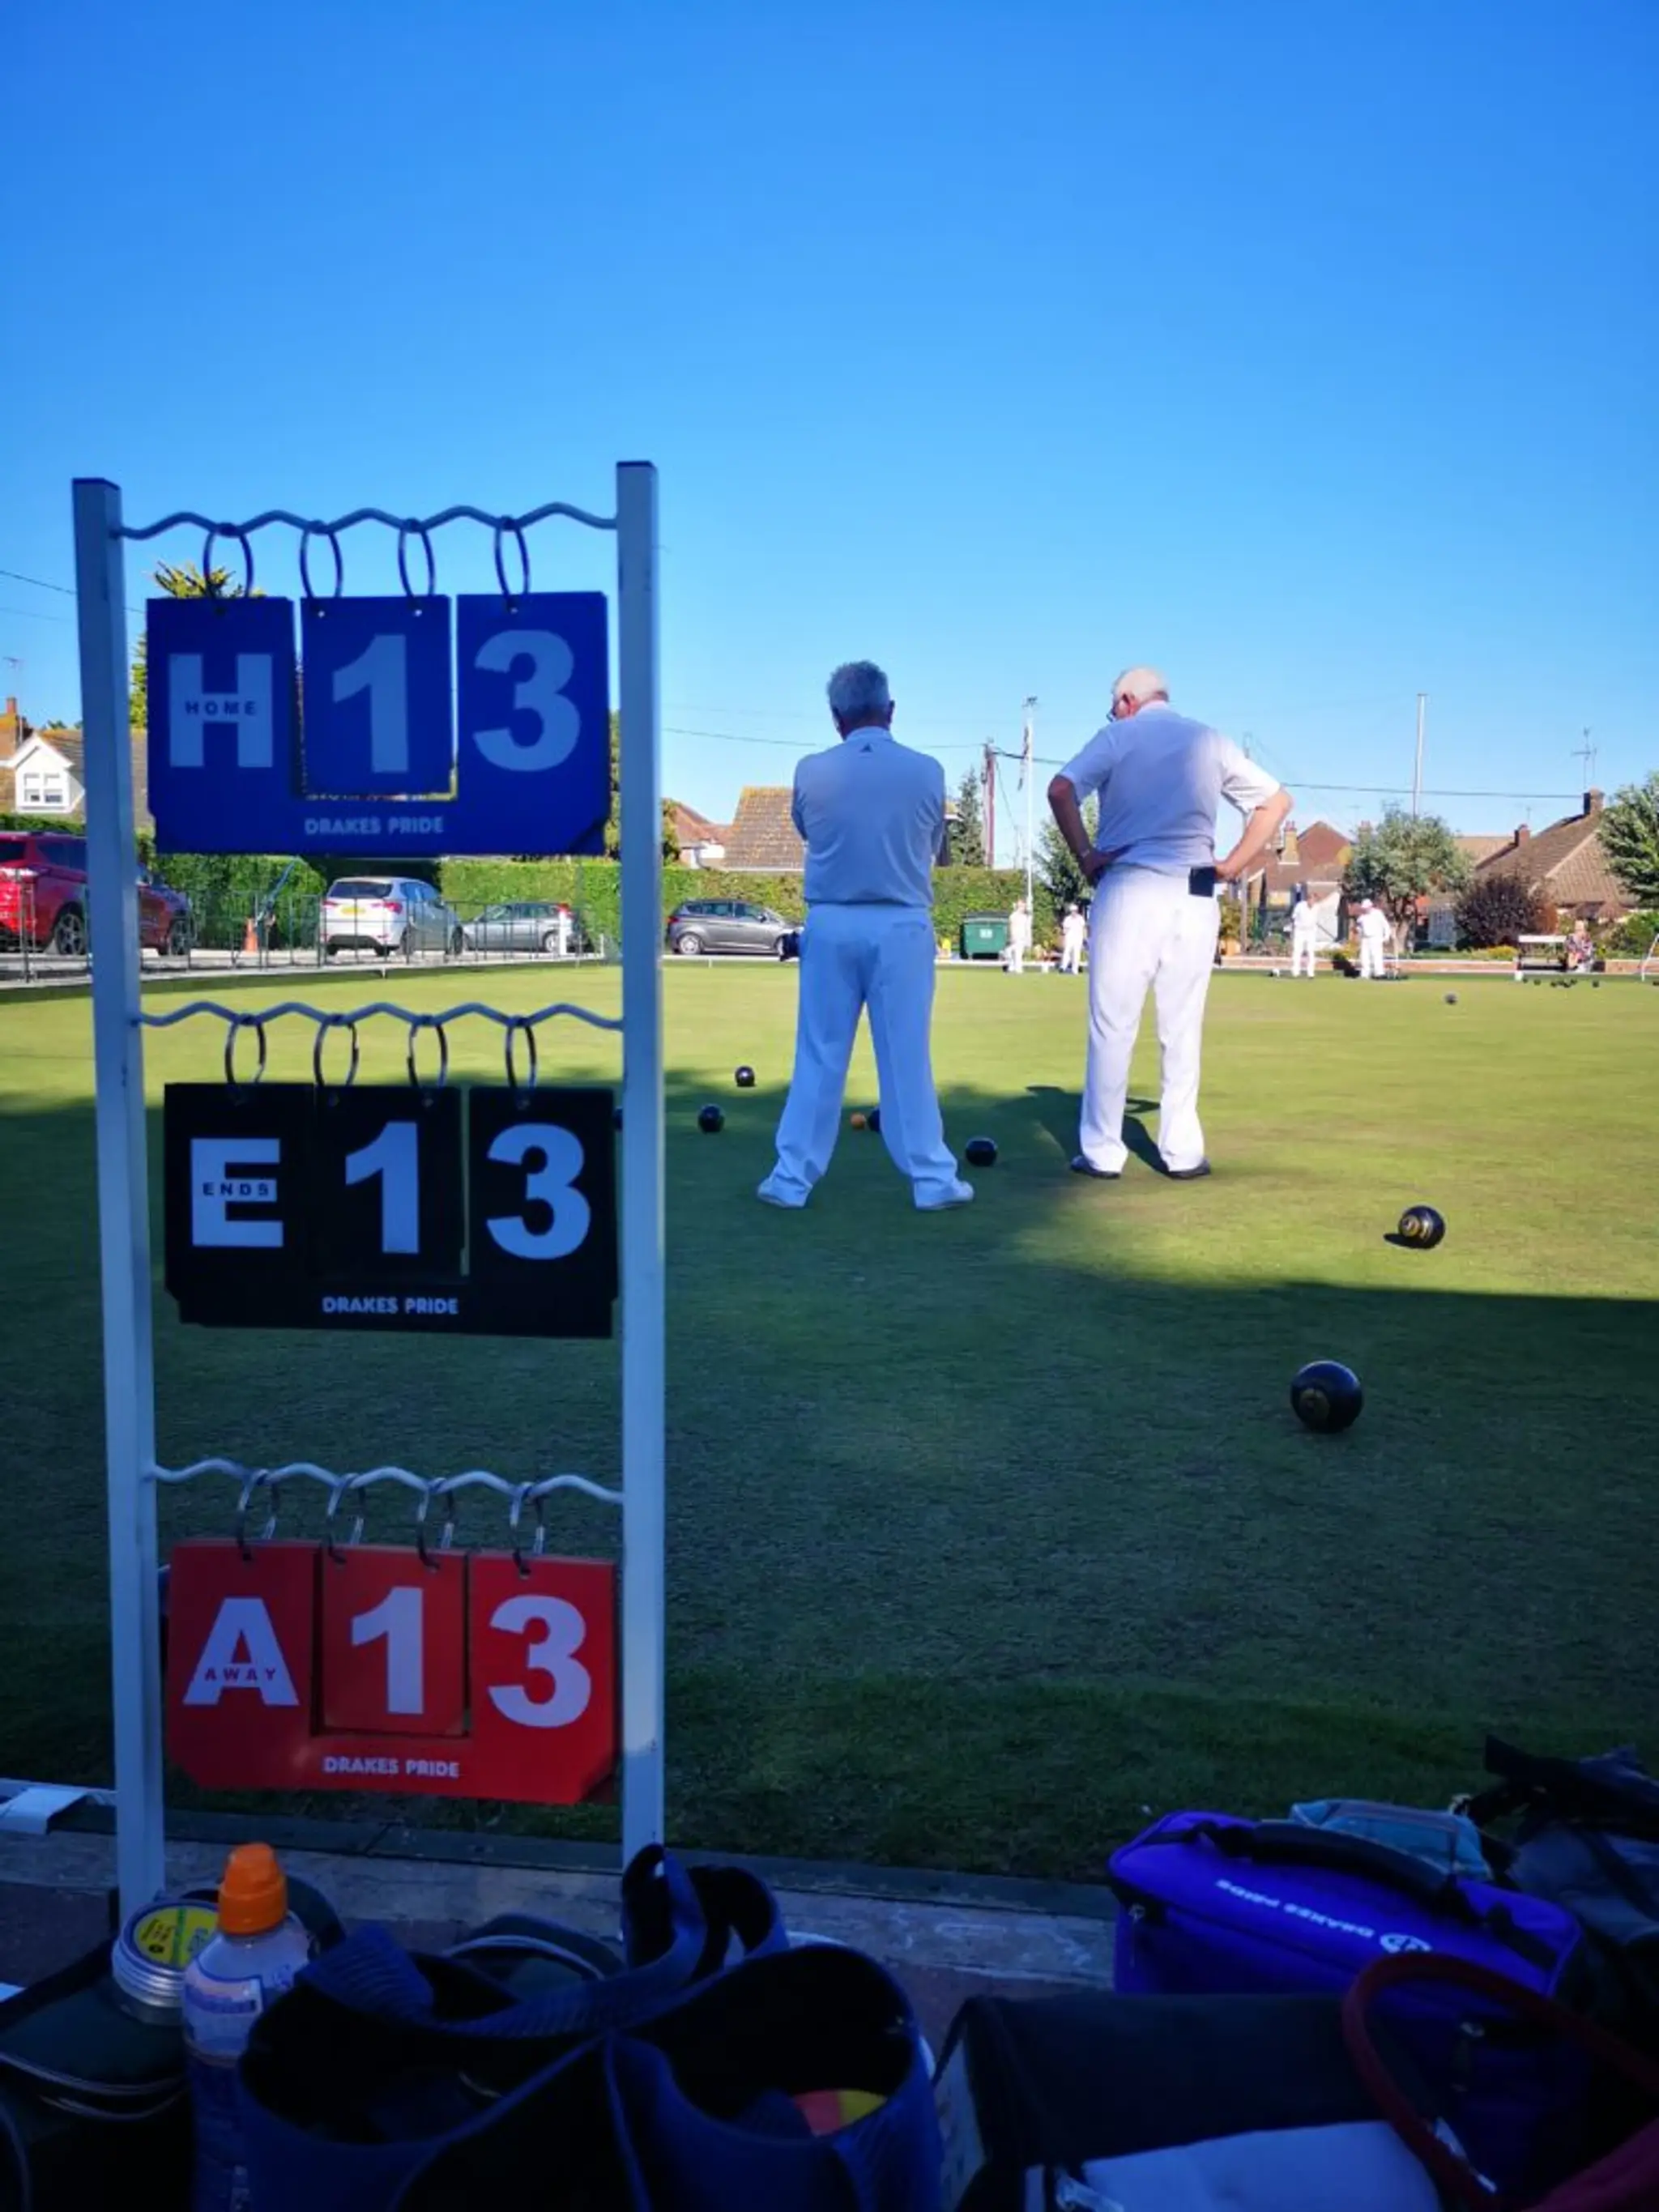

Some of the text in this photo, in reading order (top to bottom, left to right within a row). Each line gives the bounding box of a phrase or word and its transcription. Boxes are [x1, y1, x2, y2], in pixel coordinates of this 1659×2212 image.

[169, 629, 581, 774] H 1 3
[185, 700, 258, 717] HOME
[304, 815, 444, 835] DRAKES PRIDE
[191, 1122, 591, 1259] E 1 3
[202, 1182, 270, 1196] ENDS
[322, 1296, 459, 1316] DRAKES PRIDE
[182, 1586, 592, 1728] A 1 3
[204, 1667, 276, 1681] AWAY
[323, 1755, 460, 1779] DRAKES PRIDE
